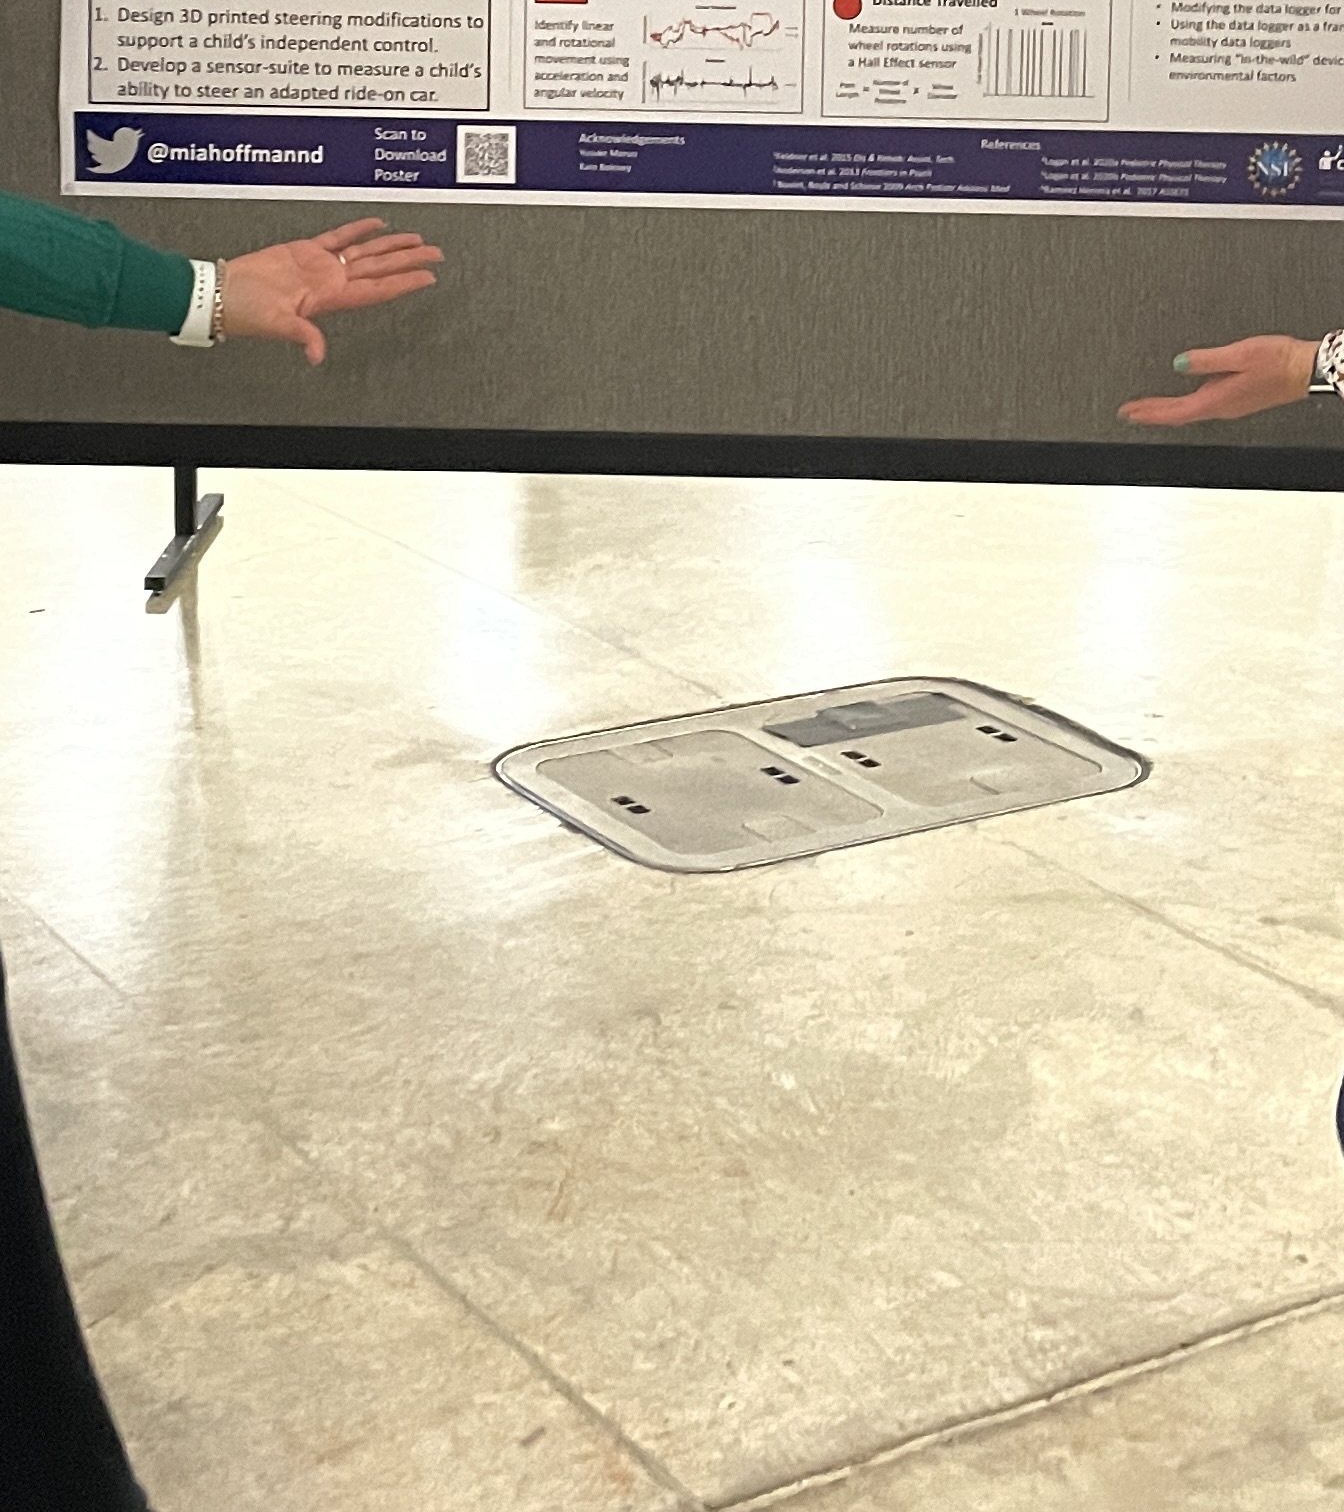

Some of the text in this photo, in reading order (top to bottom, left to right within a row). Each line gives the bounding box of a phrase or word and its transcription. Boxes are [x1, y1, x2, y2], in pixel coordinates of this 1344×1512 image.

[94, 7, 483, 30] 1. Design 3D printed steering modifications to
[117, 35, 183, 50] support
[189, 37, 197, 48] a
[260, 35, 368, 52] independent
[373, 38, 438, 53] control.
[93, 57, 108, 72] 2.
[118, 57, 186, 75] Develop
[191, 61, 200, 73] a
[206, 60, 309, 75] sensor-suite
[314, 62, 332, 76] to
[337, 65, 409, 77] measure
[414, 65, 424, 78] a
[117, 83, 438, 102] ability to steer an adapted ride-on car.
[374, 127, 426, 141] Scan to
[147, 143, 322, 163] @miahoffmannd
[374, 148, 446, 162] Download
[374, 168, 420, 182] Poster
